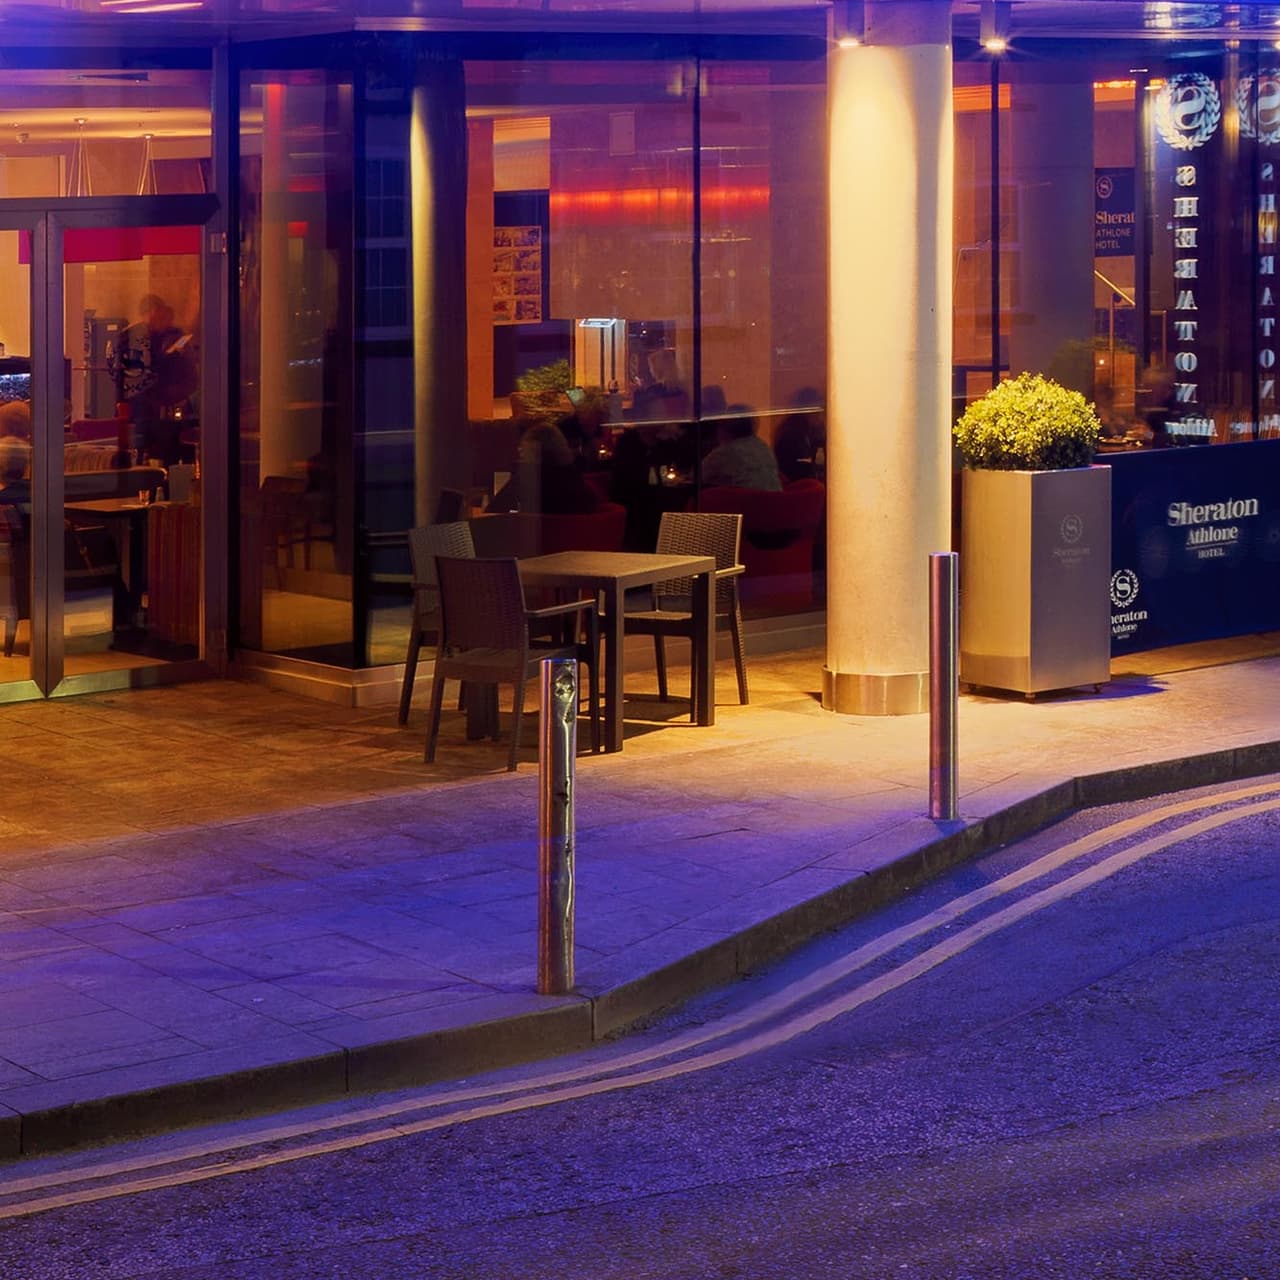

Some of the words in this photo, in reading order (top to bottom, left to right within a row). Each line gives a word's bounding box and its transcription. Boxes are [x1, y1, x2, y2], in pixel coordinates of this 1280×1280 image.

[1096, 211, 1135, 224] Sherat
[1096, 228, 1130, 238] ATHLONE
[1096, 241, 1120, 249] HOTEL
[1168, 497, 1259, 527] Sheraton
[1185, 525, 1239, 547] Athlone
[1198, 547, 1225, 559] HOTEL
